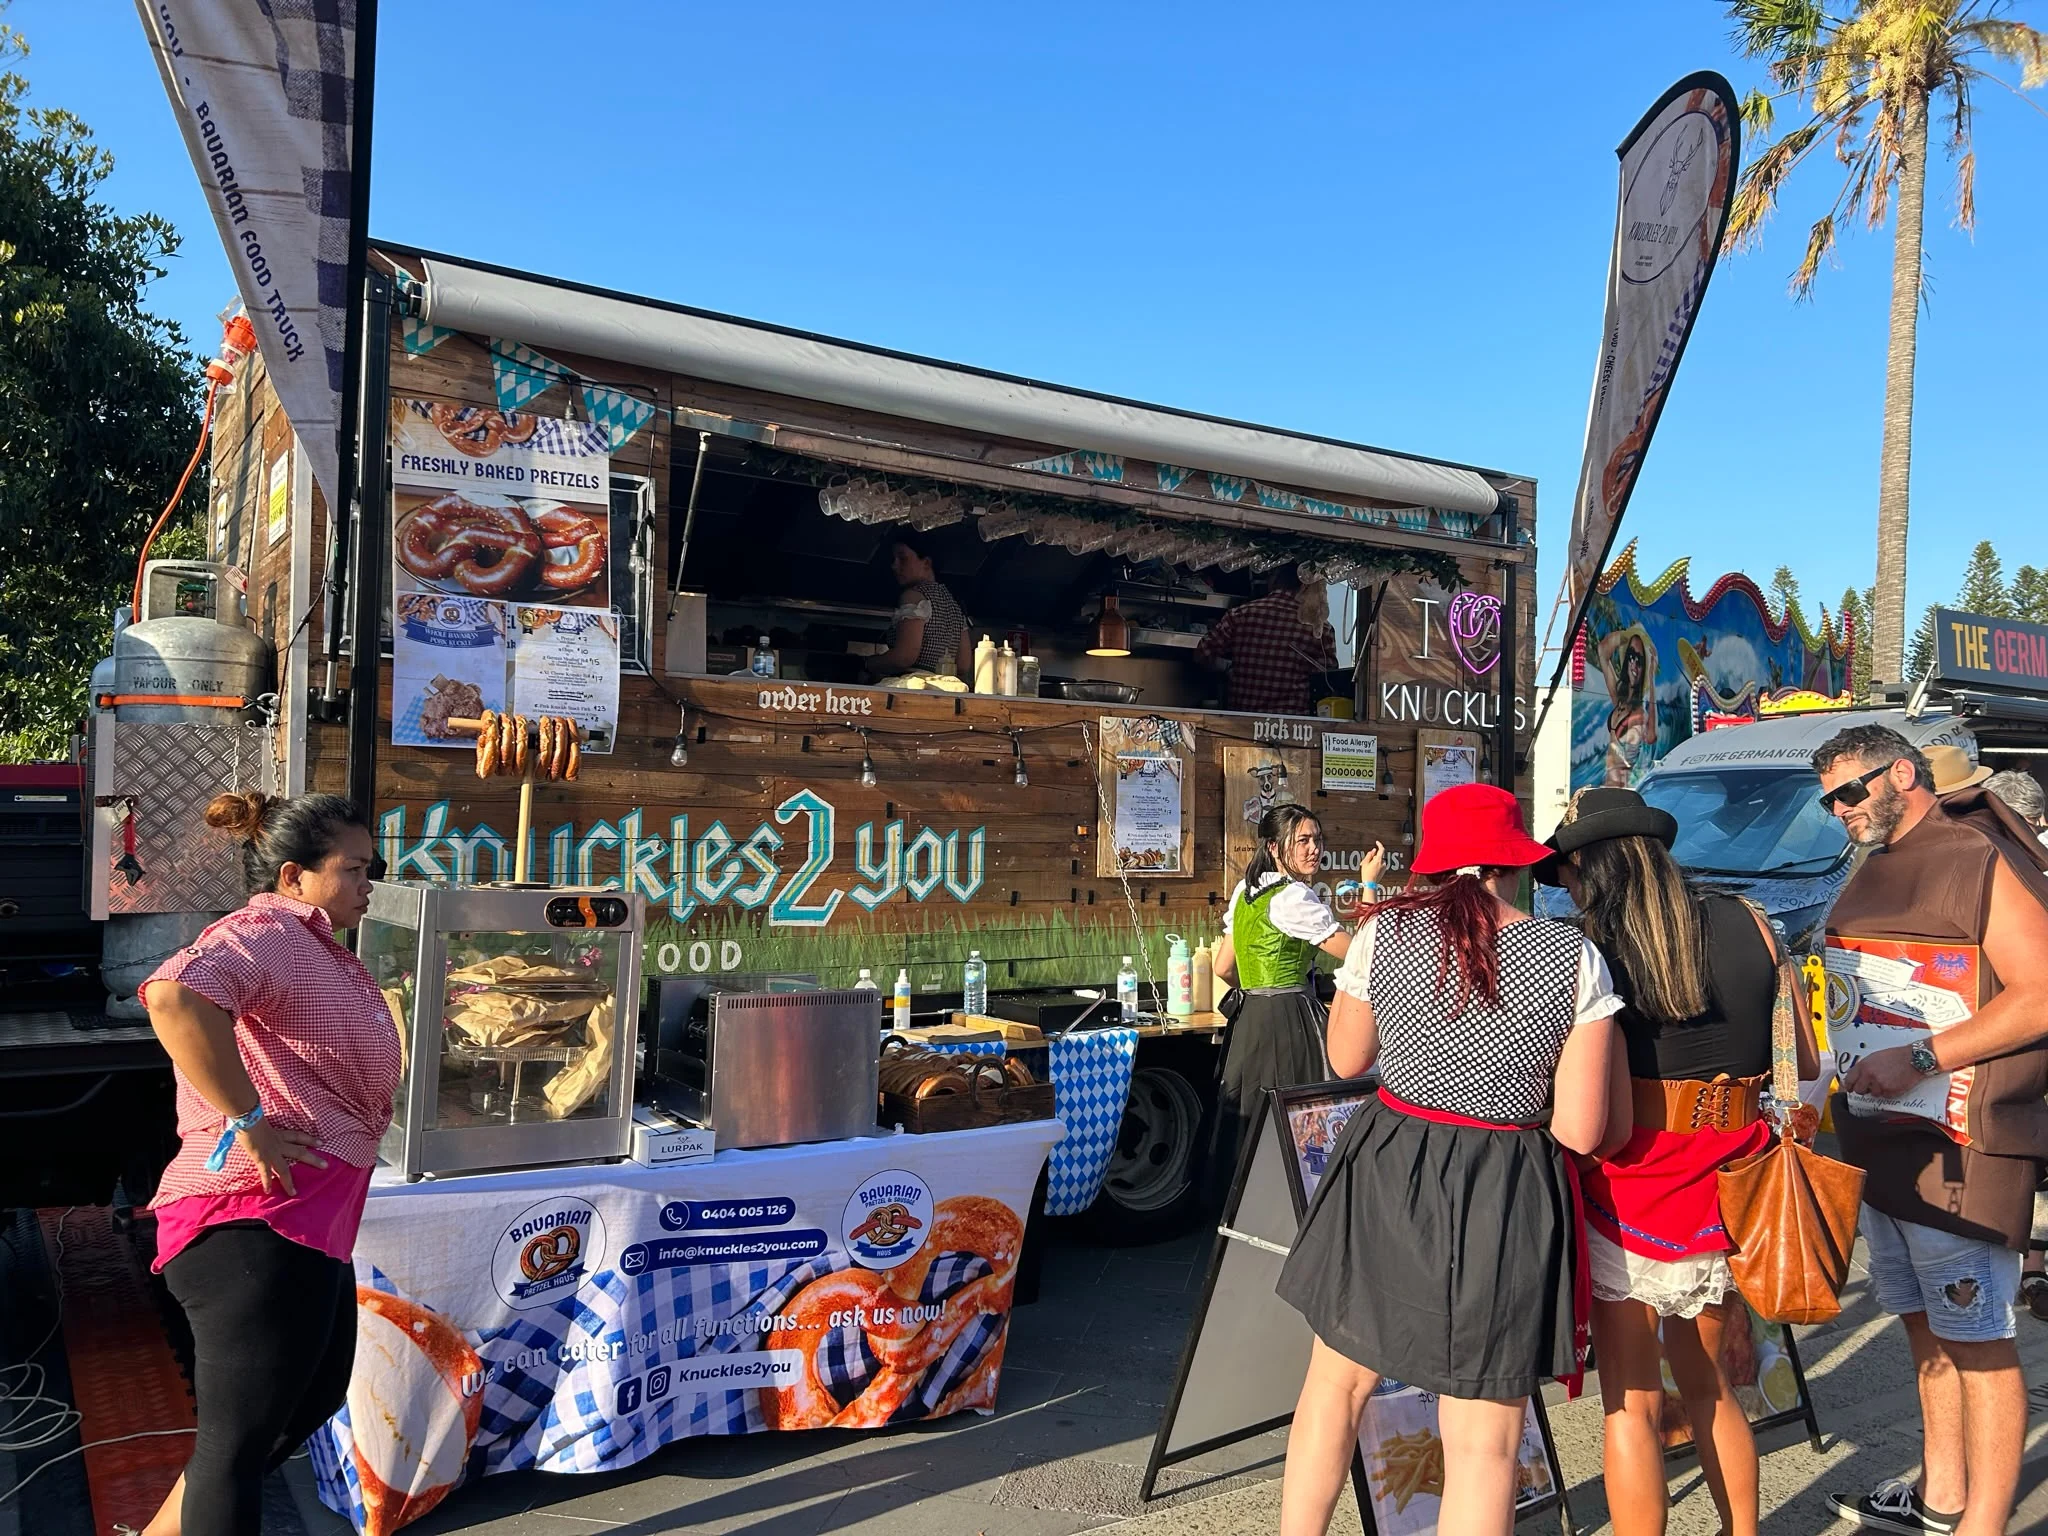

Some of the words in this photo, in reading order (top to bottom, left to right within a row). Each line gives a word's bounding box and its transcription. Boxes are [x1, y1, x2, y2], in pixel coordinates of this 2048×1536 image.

[195, 100, 249, 225] BAVARIAN
[240, 228, 270, 288] FOOD
[267, 288, 305, 364] TRUCK
[1603, 354, 1616, 385] CHEESE
[401, 454, 469, 476] FRESHLY
[474, 462, 525, 482] BAKED
[530, 468, 600, 490] PRETZELS
[1951, 622, 1991, 671] THE
[192, 679, 224, 692] ONLY
[759, 685, 821, 712] order
[825, 687, 873, 715] here
[1381, 682, 1526, 731] KNUCKLS
[1253, 718, 1290, 743] pick
[1293, 723, 1313, 747] up
[1332, 737, 1348, 745] Food
[1350, 739, 1375, 748] Allergy?
[769, 788, 845, 928] 2
[849, 818, 986, 912] you
[1320, 850, 1366, 871] OLLO
[642, 940, 743, 973] OOD
[661, 1142, 704, 1155] LURPAK
[859, 1184, 922, 1204] BAVARIAN
[865, 1198, 886, 1208] PRETZEL
[701, 1206, 737, 1220] 0404
[738, 1205, 764, 1219] 005
[766, 1203, 788, 1218] 126
[509, 1210, 592, 1244] BAVARIAN
[658, 1237, 820, 1261] info@knuckles2you.com
[876, 1249, 892, 1257] HAUS
[523, 1281, 552, 1297] PRETZEL
[553, 1272, 575, 1287] HAUS
[461, 1367, 496, 1399] We
[503, 1348, 547, 1374] can
[557, 1338, 624, 1364] cater
[628, 1328, 657, 1358] for
[660, 1322, 688, 1346] all
[692, 1310, 821, 1342] functions...
[828, 1307, 867, 1330] ask
[873, 1306, 896, 1325] us
[901, 1300, 947, 1324] now!
[679, 1358, 792, 1384] Knuckles2you
